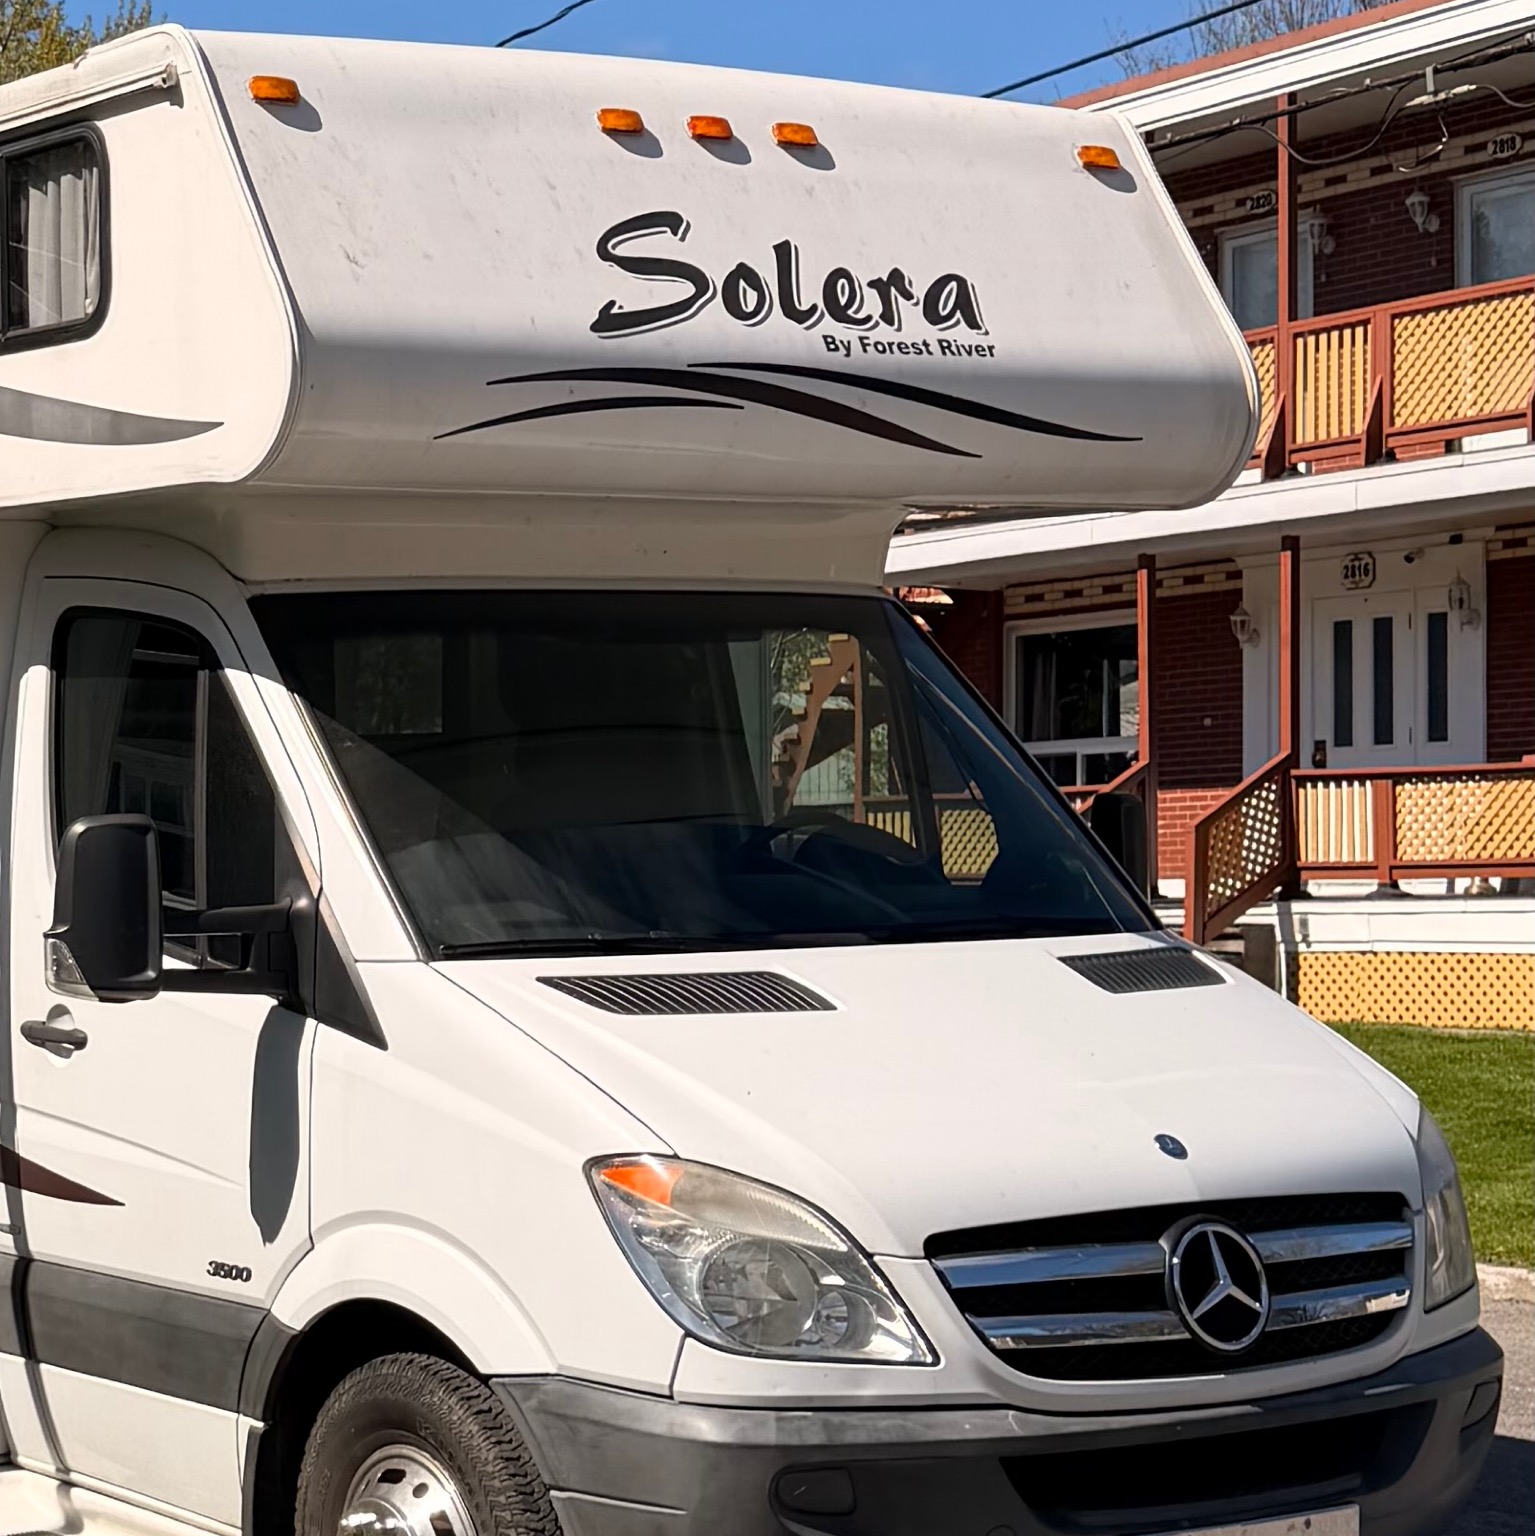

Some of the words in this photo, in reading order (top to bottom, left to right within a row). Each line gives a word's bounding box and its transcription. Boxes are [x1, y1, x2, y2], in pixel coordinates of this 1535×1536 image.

[590, 211, 989, 338] Solera
[822, 334, 851, 358] By
[858, 335, 933, 356] Forest
[937, 338, 996, 358] River
[1343, 562, 1370, 579] 2816
[206, 1260, 252, 1282] 3500
